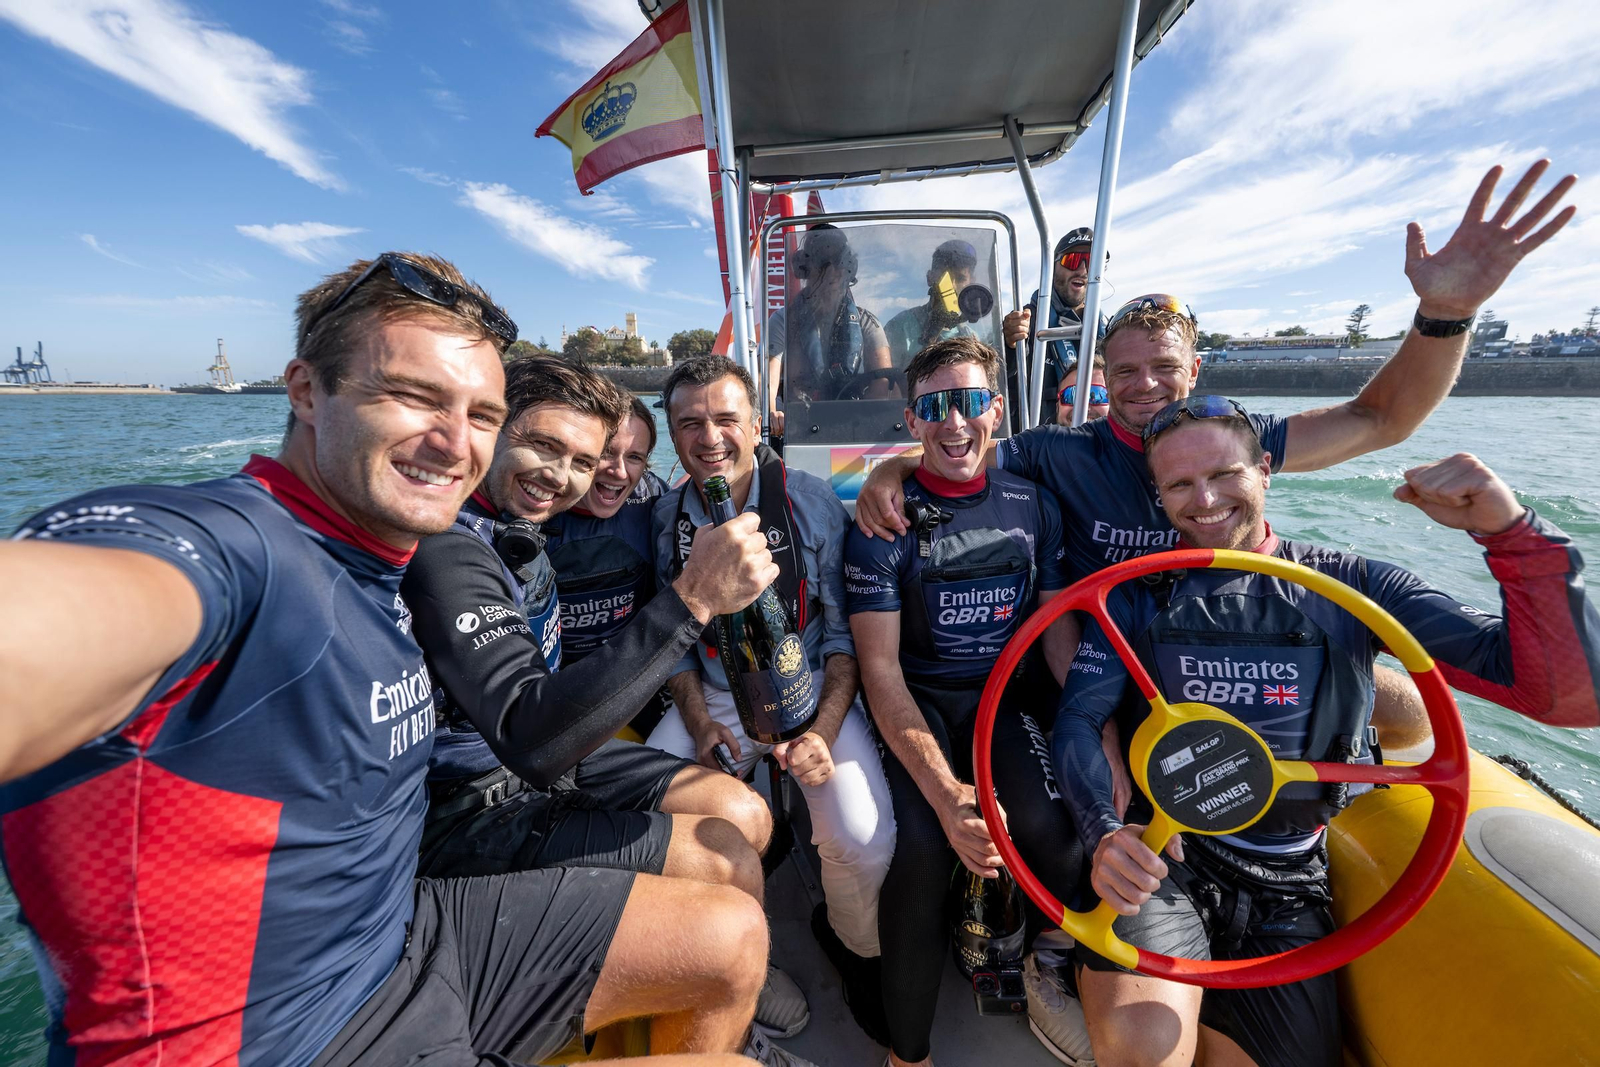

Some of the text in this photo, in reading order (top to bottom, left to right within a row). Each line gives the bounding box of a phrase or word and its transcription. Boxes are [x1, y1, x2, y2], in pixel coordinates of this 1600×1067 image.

[1068, 234, 1093, 244] SAIL
[677, 519, 692, 569] SAIL
[559, 590, 635, 616] Emirates
[939, 586, 1016, 608] Emirates
[479, 605, 504, 616] low
[560, 610, 610, 629] GBR
[938, 606, 991, 626] GBR
[1178, 655, 1299, 680] Emirates
[1182, 679, 1257, 705] GBR
[763, 702, 779, 712] DE
[388, 700, 436, 761] FLY BETT
[1020, 711, 1062, 801] Emirates
[1173, 757, 1190, 767] ROLEX
[1196, 782, 1252, 814] WINNER
[1206, 804, 1232, 820] OCTOBER
